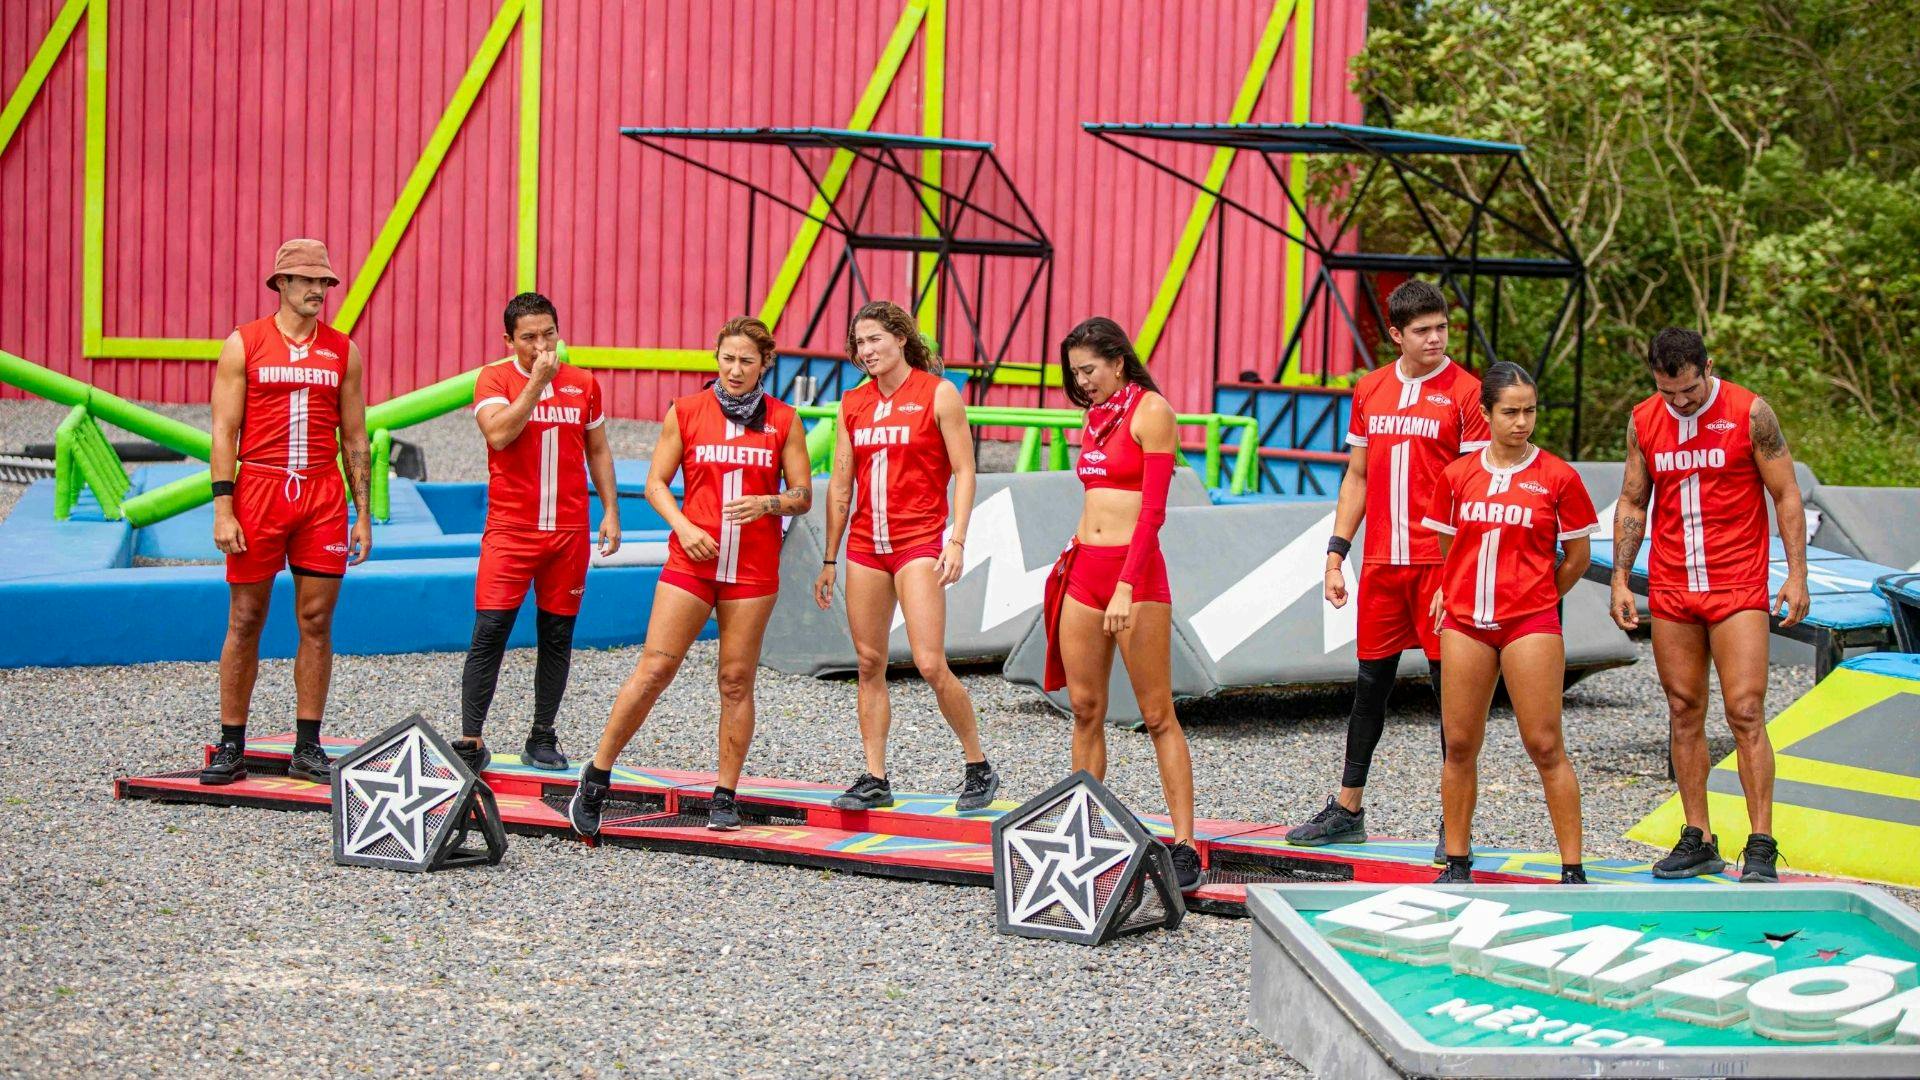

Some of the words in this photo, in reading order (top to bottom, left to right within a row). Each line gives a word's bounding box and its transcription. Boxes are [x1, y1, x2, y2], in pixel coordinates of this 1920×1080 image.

[258, 366, 339, 388] HUMBERTO
[528, 405, 581, 425] LLALUZ
[854, 425, 910, 447] MATI
[1368, 415, 1441, 440] BENYAMIN
[695, 444, 774, 468] PAULETTE
[1654, 448, 1726, 472] MONO
[1079, 466, 1107, 476] JAZMIN
[1459, 501, 1534, 529] KAROL
